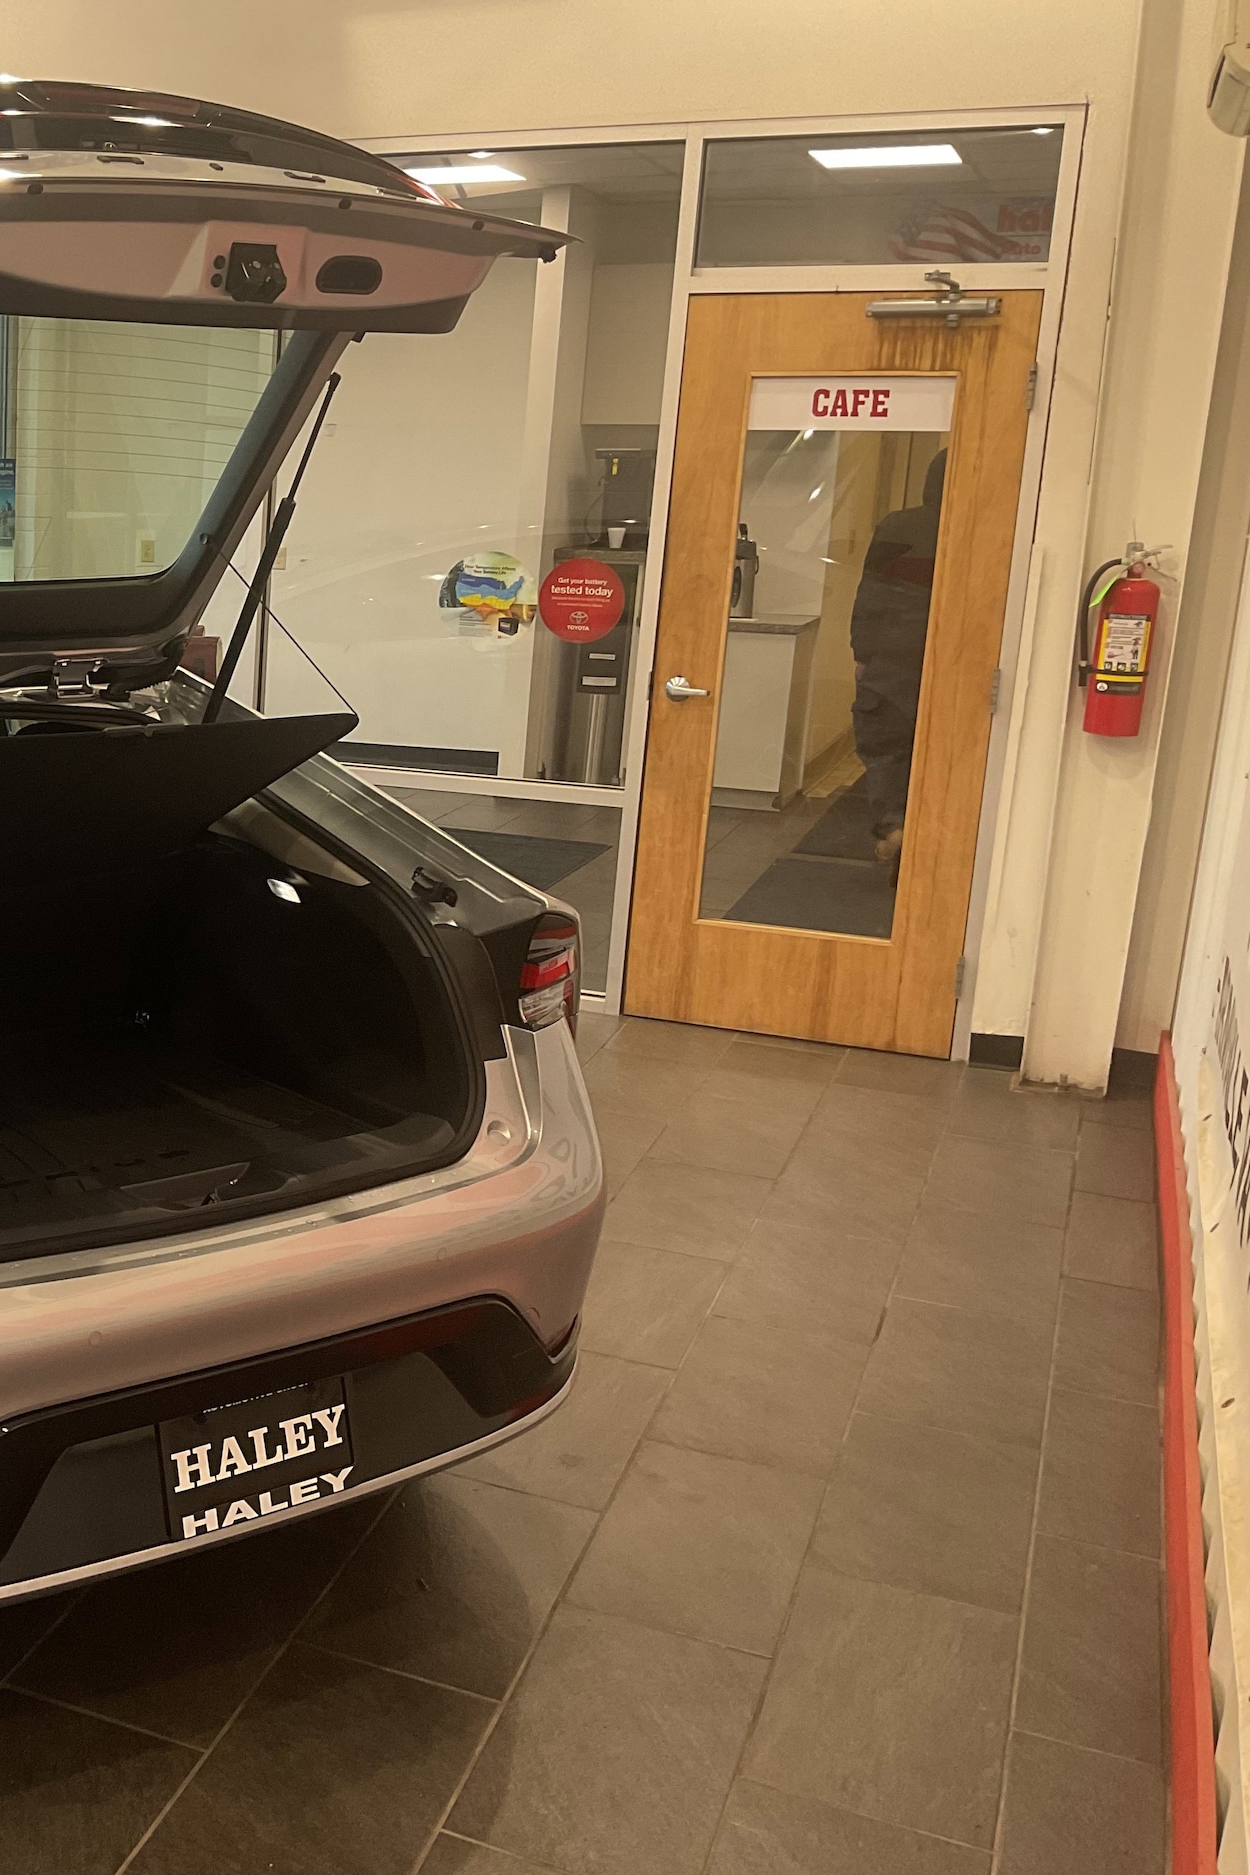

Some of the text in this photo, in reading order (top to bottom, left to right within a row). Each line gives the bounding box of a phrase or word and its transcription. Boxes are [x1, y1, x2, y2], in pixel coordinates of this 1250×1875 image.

[812, 389, 890, 418] CAFE
[551, 585, 614, 598] tested today
[584, 578, 608, 587] battery
[170, 1403, 346, 1494] HALEY
[182, 1465, 354, 1539] HALEY
